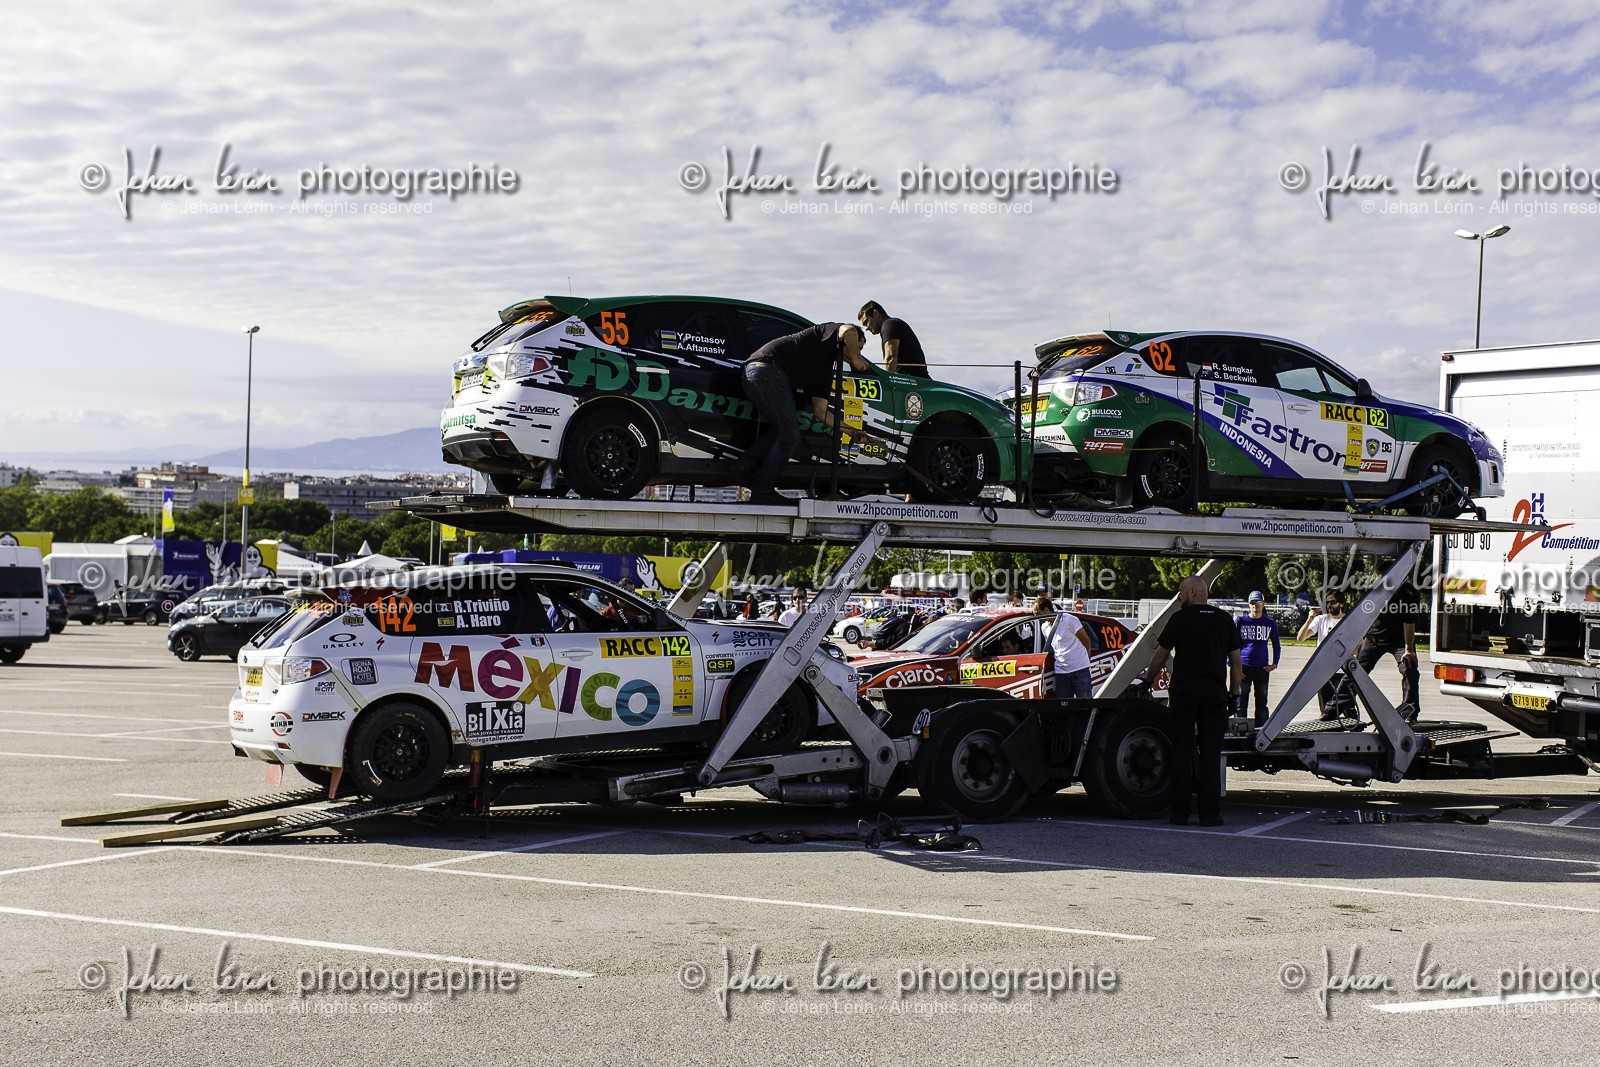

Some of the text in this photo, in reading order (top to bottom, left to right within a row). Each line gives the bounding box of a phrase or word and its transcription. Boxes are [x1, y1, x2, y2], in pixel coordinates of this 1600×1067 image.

[601, 311, 629, 345] 55
[1149, 342, 1175, 371] 62
[1222, 364, 1253, 374] Sungkar
[1224, 373, 1257, 383] Beckwith
[859, 380, 877, 398] 55
[1325, 403, 1384, 427] RACC 62
[1219, 421, 1273, 468] INDONESIA
[837, 503, 958, 520] www.2hpcompetition.com
[1241, 520, 1344, 534] www.2hpcompetition.com
[1464, 533, 1474, 549] 80
[1480, 533, 1490, 550] 90
[1541, 531, 1600, 551] Compétition
[453, 598, 510, 613] R.Triviño
[378, 597, 416, 632] 142
[456, 614, 501, 628] A. Haro
[747, 638, 774, 647] CITY
[1101, 626, 1124, 649] 132
[606, 637, 691, 656] RACC 142
[708, 660, 733, 669] QSP
[981, 662, 1011, 676] RACC
[1513, 696, 1529, 705] 6719
[1531, 698, 1538, 707] VB
[914, 711, 930, 730] 90
